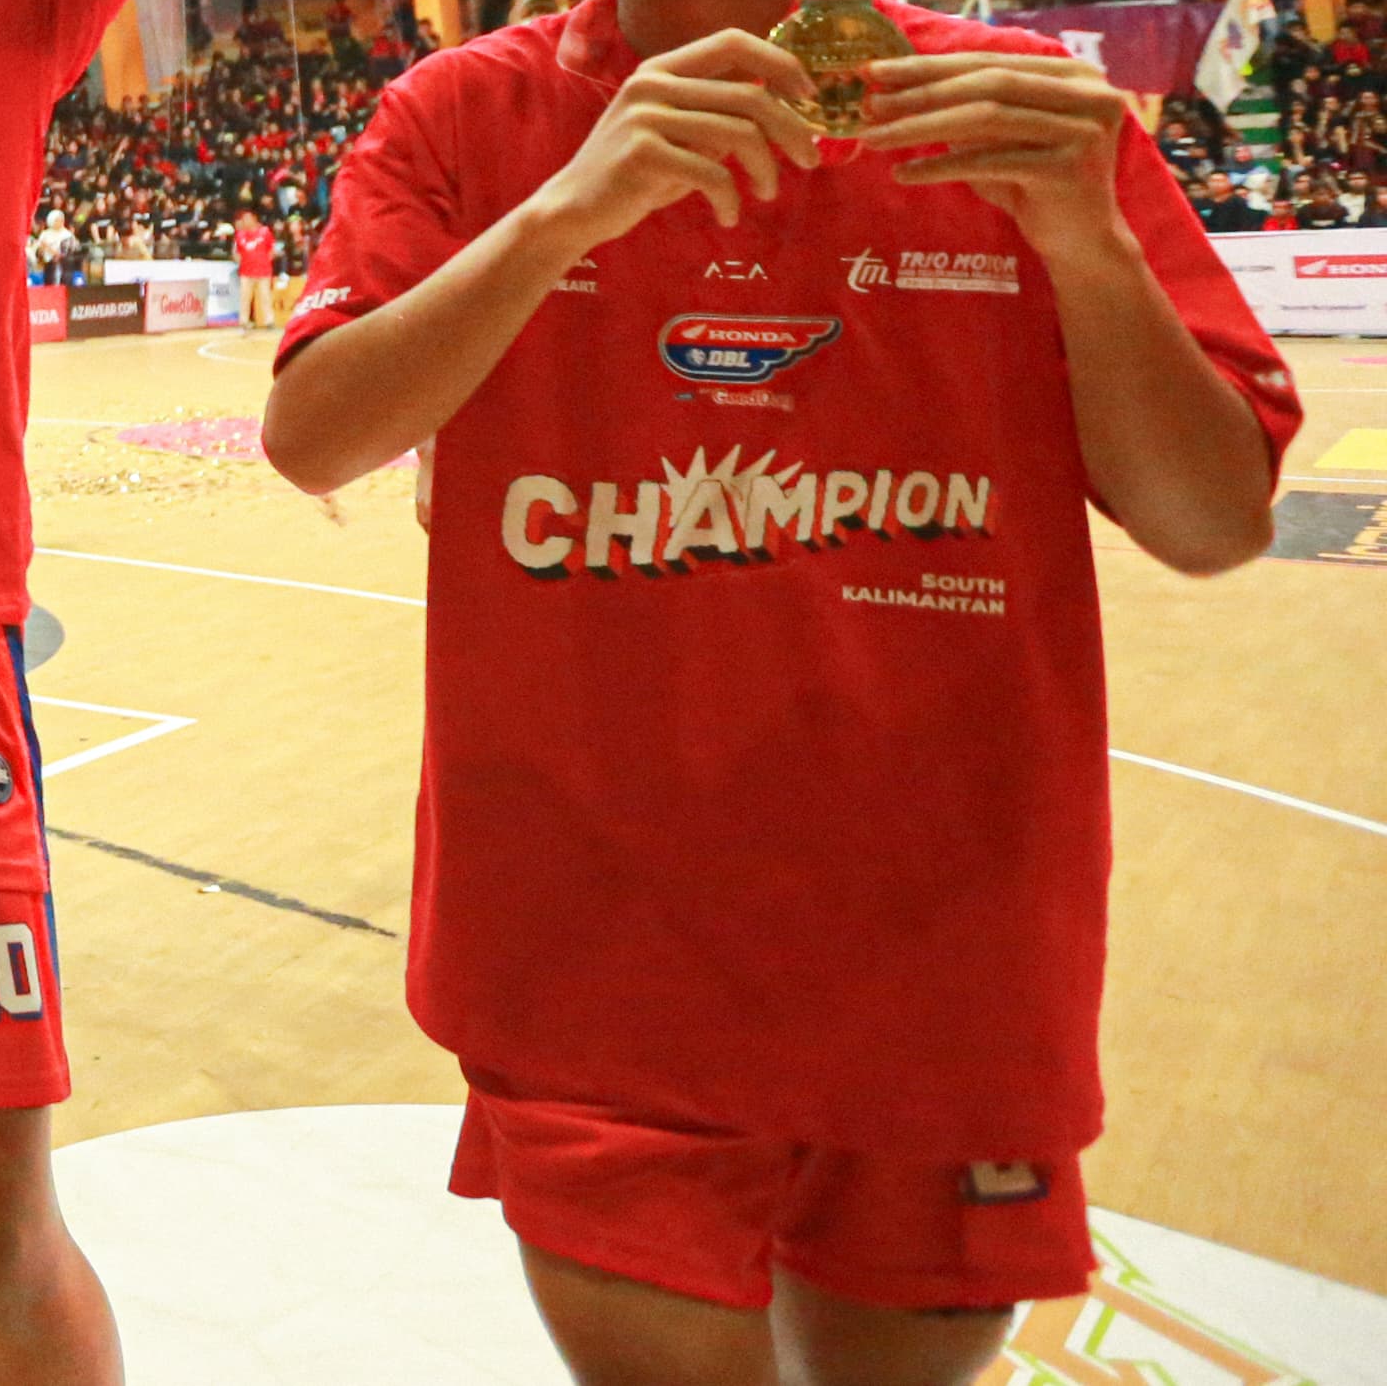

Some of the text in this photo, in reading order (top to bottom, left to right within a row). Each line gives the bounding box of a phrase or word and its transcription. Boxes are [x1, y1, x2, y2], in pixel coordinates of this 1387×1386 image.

[899, 250, 950, 270] TRIO
[953, 252, 1019, 273] MOTOR
[1328, 263, 1387, 276] HON
[30, 310, 60, 325] NDA
[707, 328, 797, 343] HONDA
[707, 349, 752, 368] DBL
[502, 466, 995, 580] CHAMPION
[920, 572, 1006, 595] SOUTH
[841, 585, 1006, 616] KALIMANTAN
